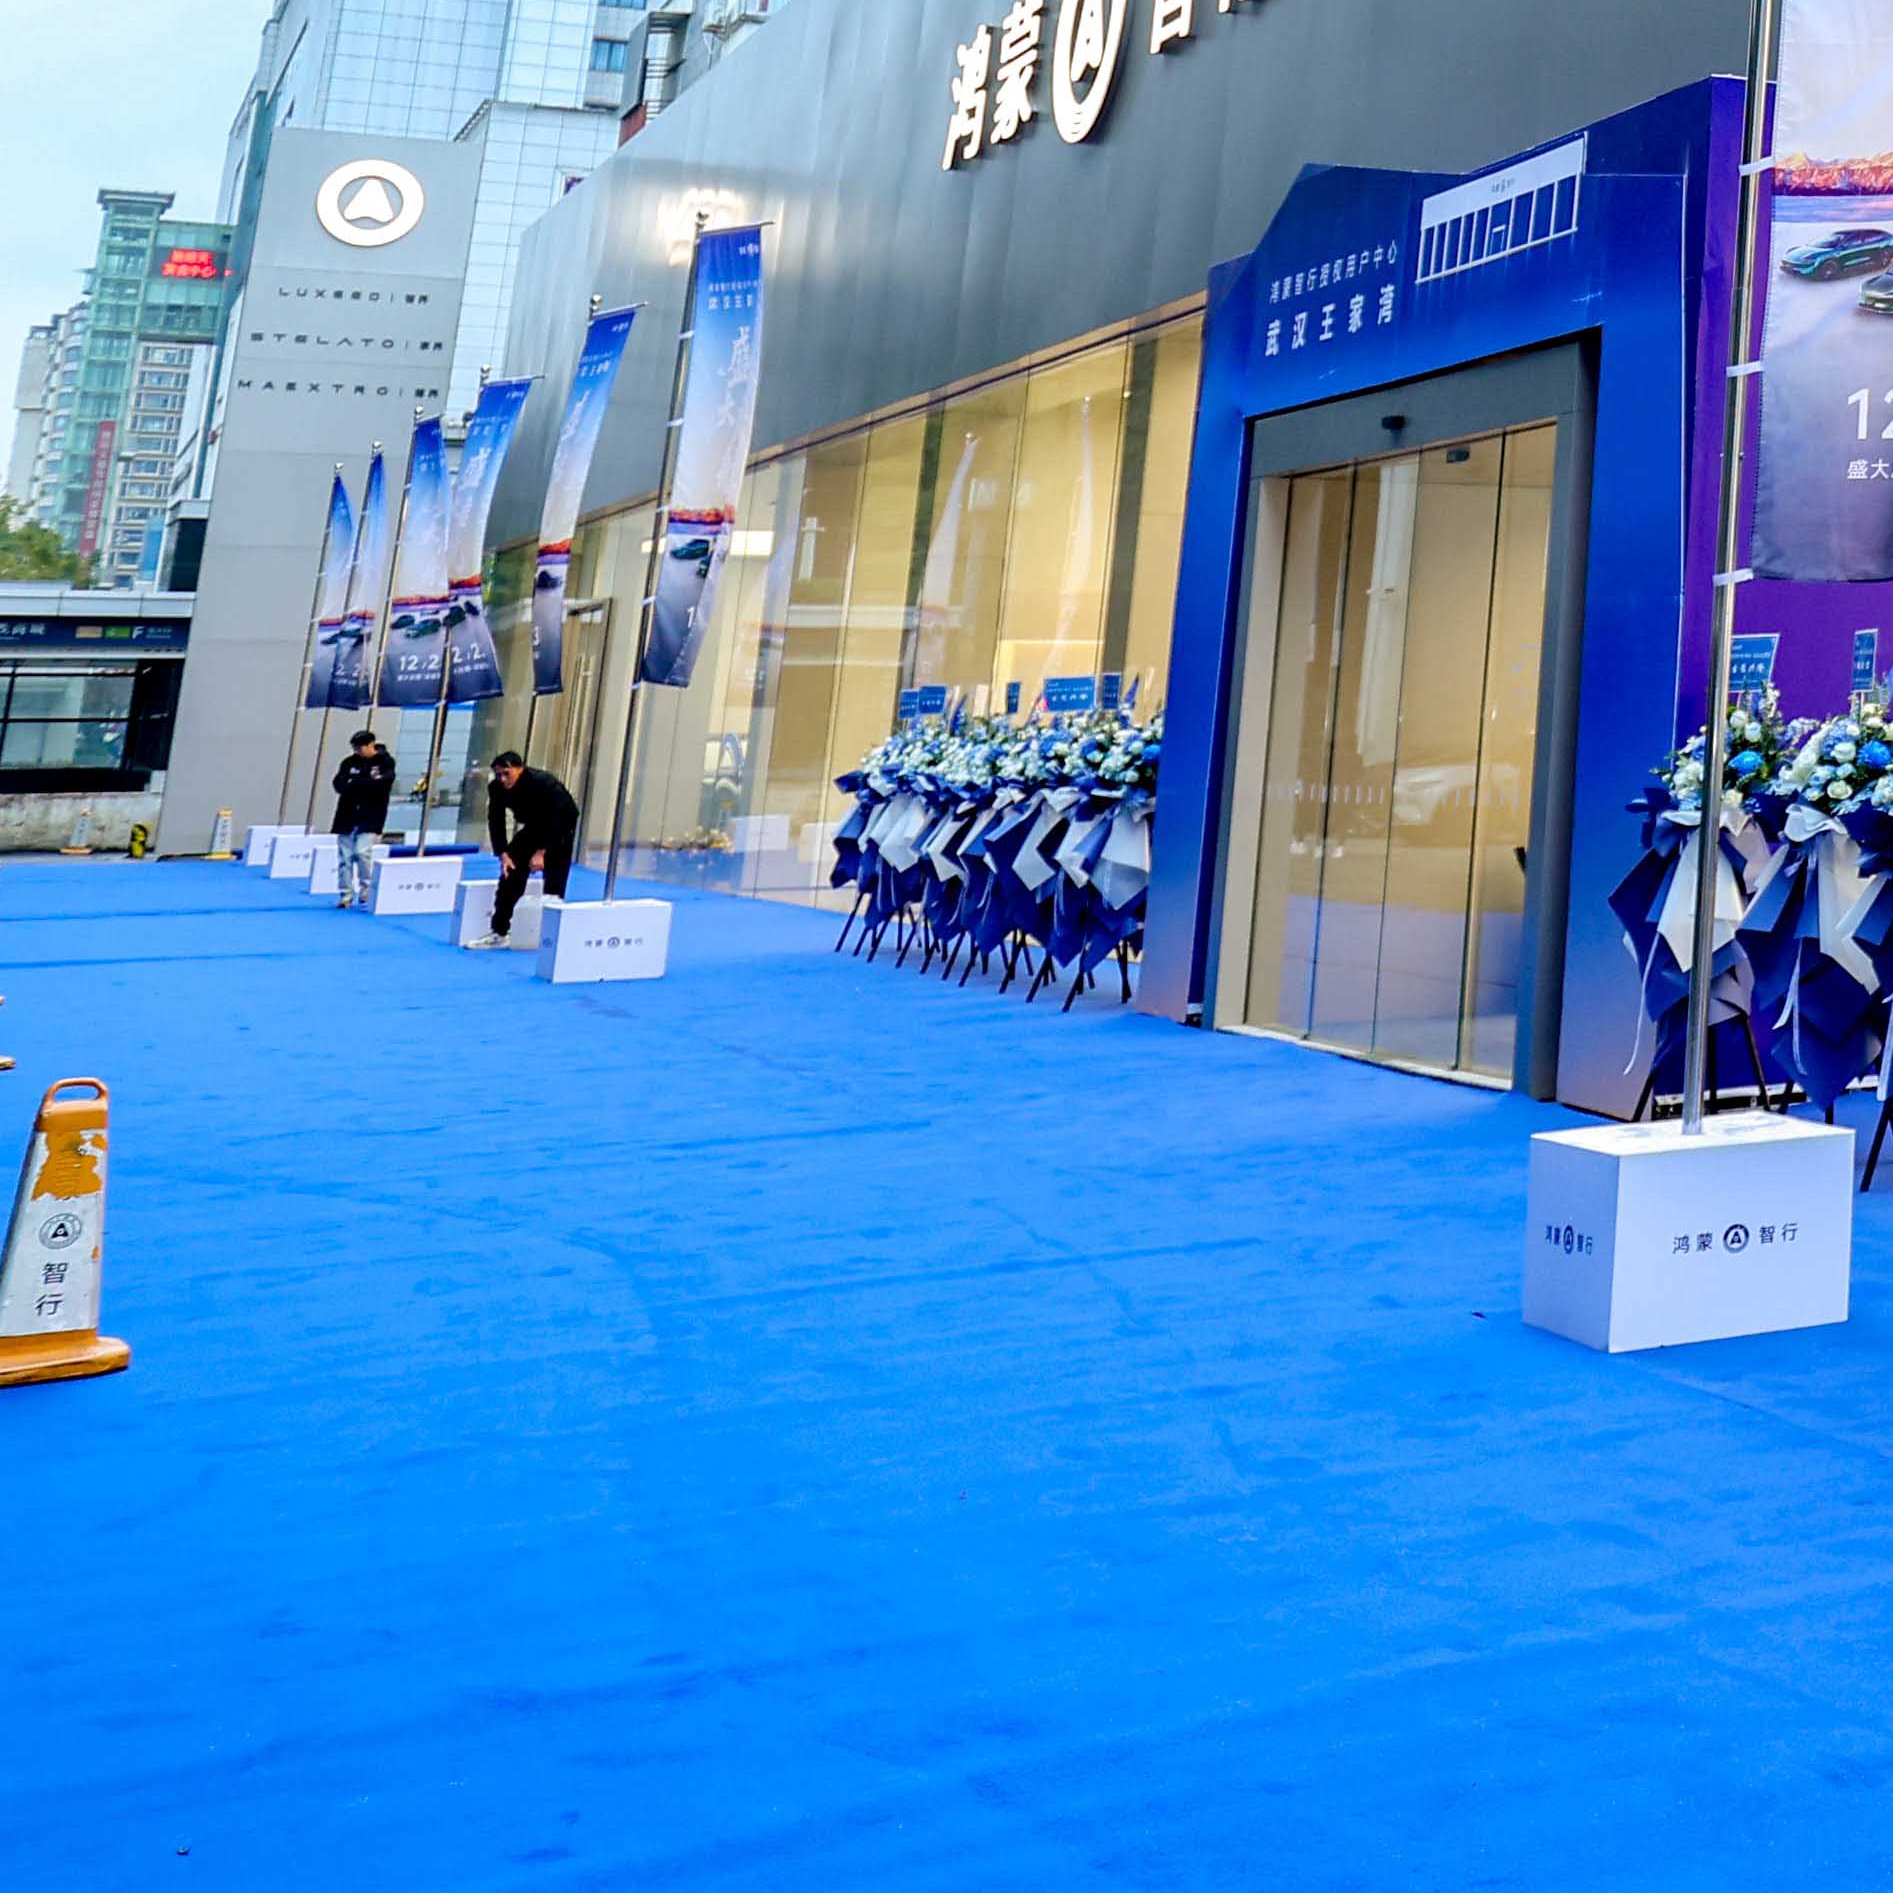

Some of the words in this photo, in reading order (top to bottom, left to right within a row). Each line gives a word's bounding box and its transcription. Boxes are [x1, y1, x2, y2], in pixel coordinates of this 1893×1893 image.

[1265, 283, 1396, 357] 武汉王家湾
[1672, 1233, 1713, 1254] 鸿蒙
[1759, 1222, 1800, 1244] 智行
[35, 1262, 68, 1317] 智行
